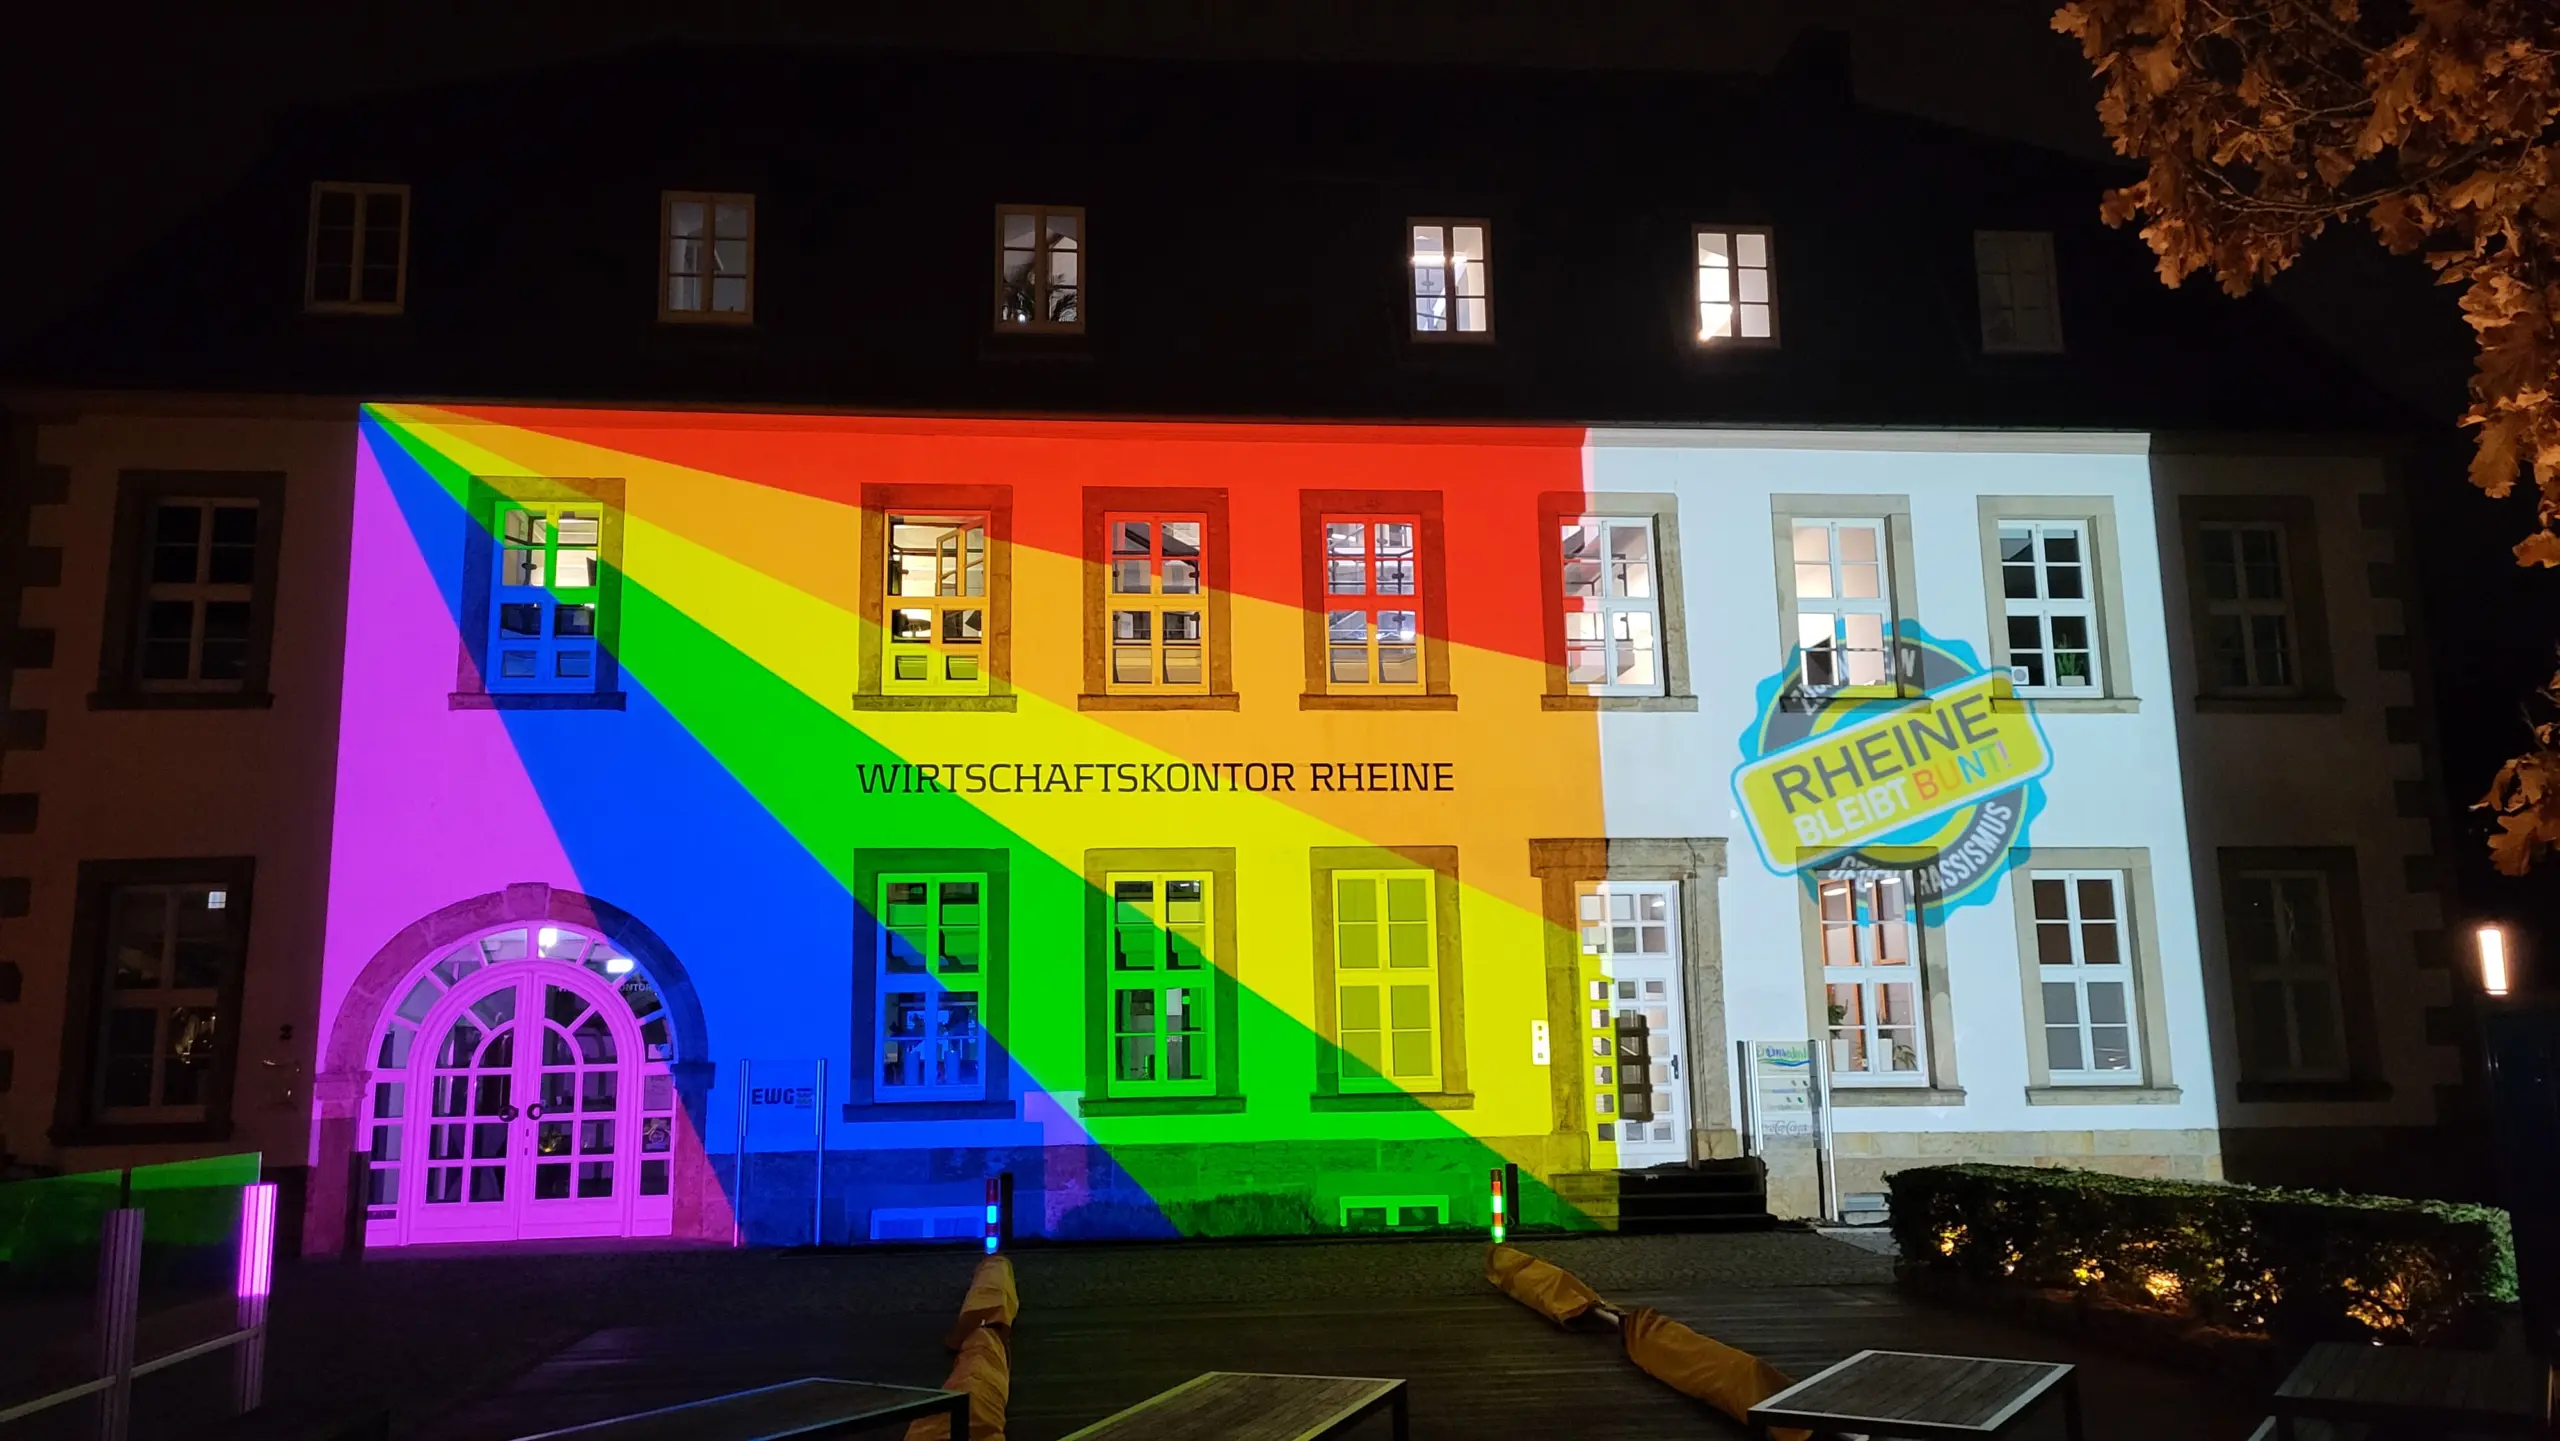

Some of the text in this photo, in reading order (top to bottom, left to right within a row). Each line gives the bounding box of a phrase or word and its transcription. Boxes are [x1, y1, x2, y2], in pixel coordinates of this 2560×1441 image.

[856, 762, 1455, 794] WIRTSCHAFTSKONTOR RHEINE
[1772, 692, 1999, 813] RHEINE
[1793, 739, 2012, 847] BLEIBT BUNT!
[1918, 801, 2012, 896] RASSISMUS
[751, 1087, 795, 1105] EWG
